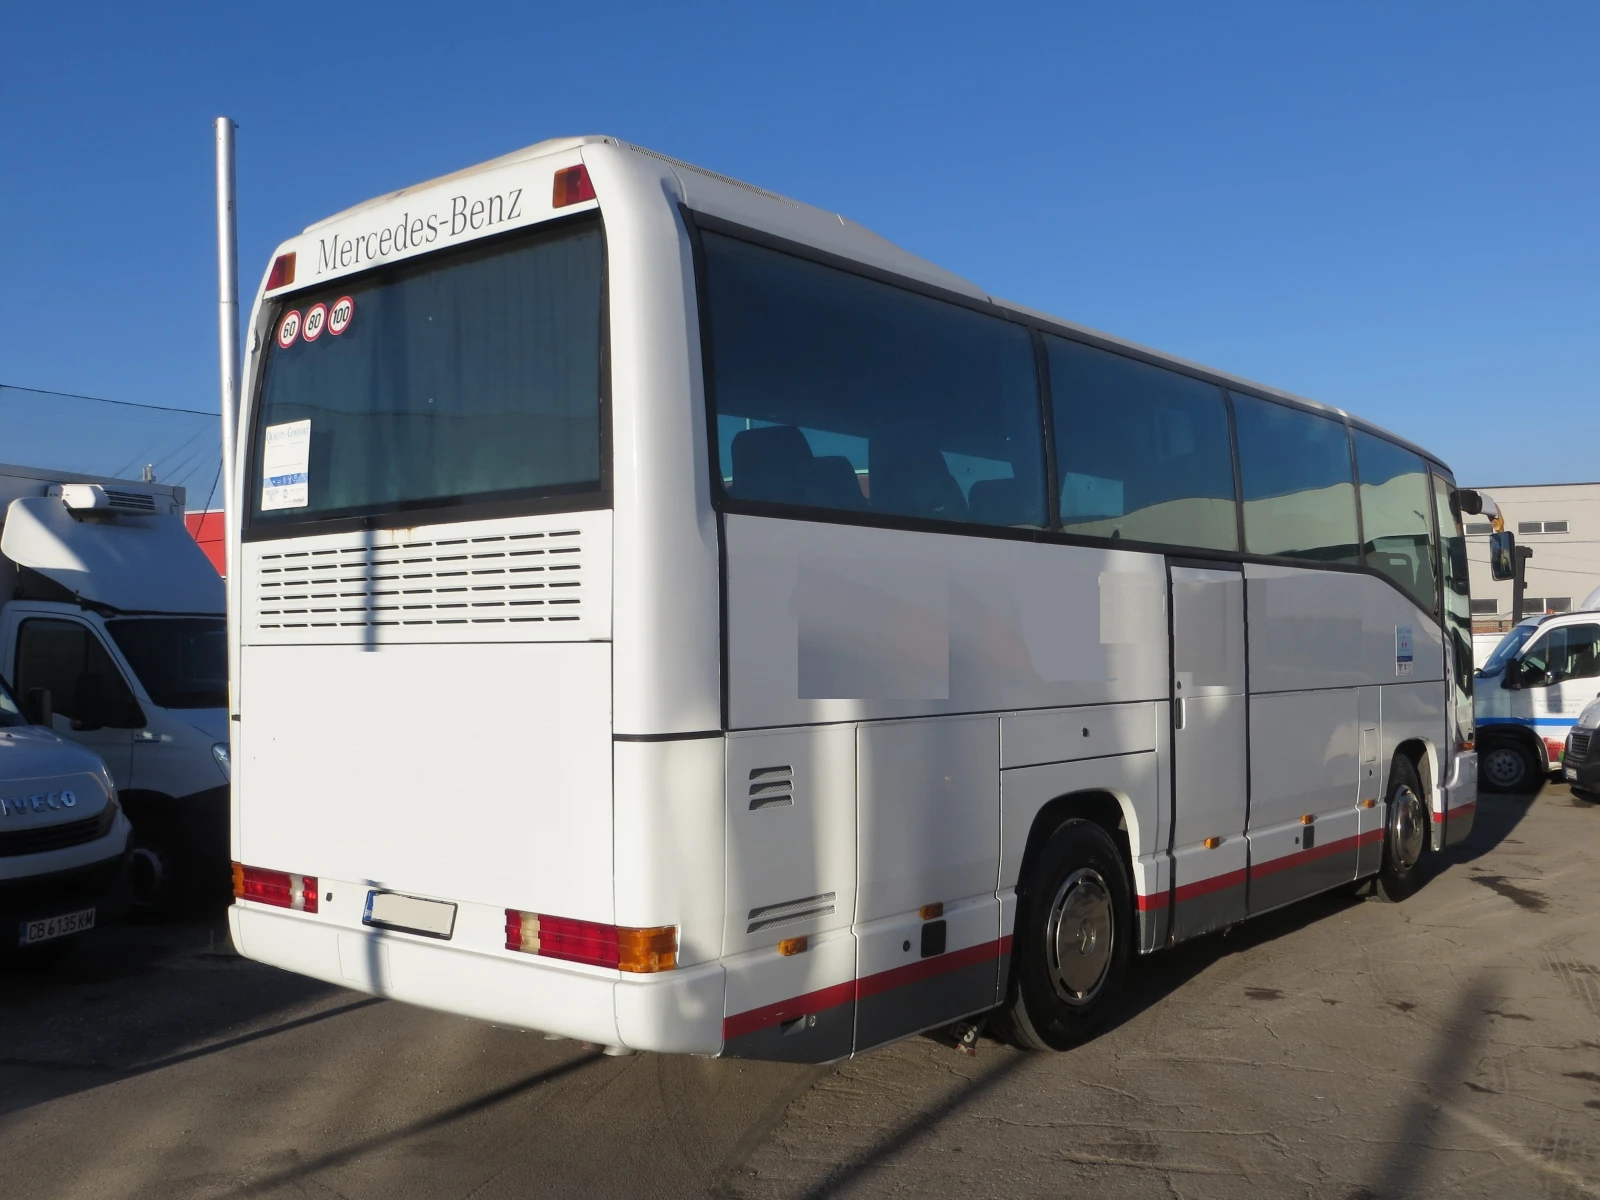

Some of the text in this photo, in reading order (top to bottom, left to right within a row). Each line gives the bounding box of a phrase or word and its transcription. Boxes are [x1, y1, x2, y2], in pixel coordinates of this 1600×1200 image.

[316, 188, 523, 276] Mercedes-Benz
[308, 313, 322, 331] 80
[333, 306, 350, 325] 100
[283, 321, 296, 338] 60
[0, 790, 77, 816] IVECO
[29, 911, 94, 940] CB 6135 KM
